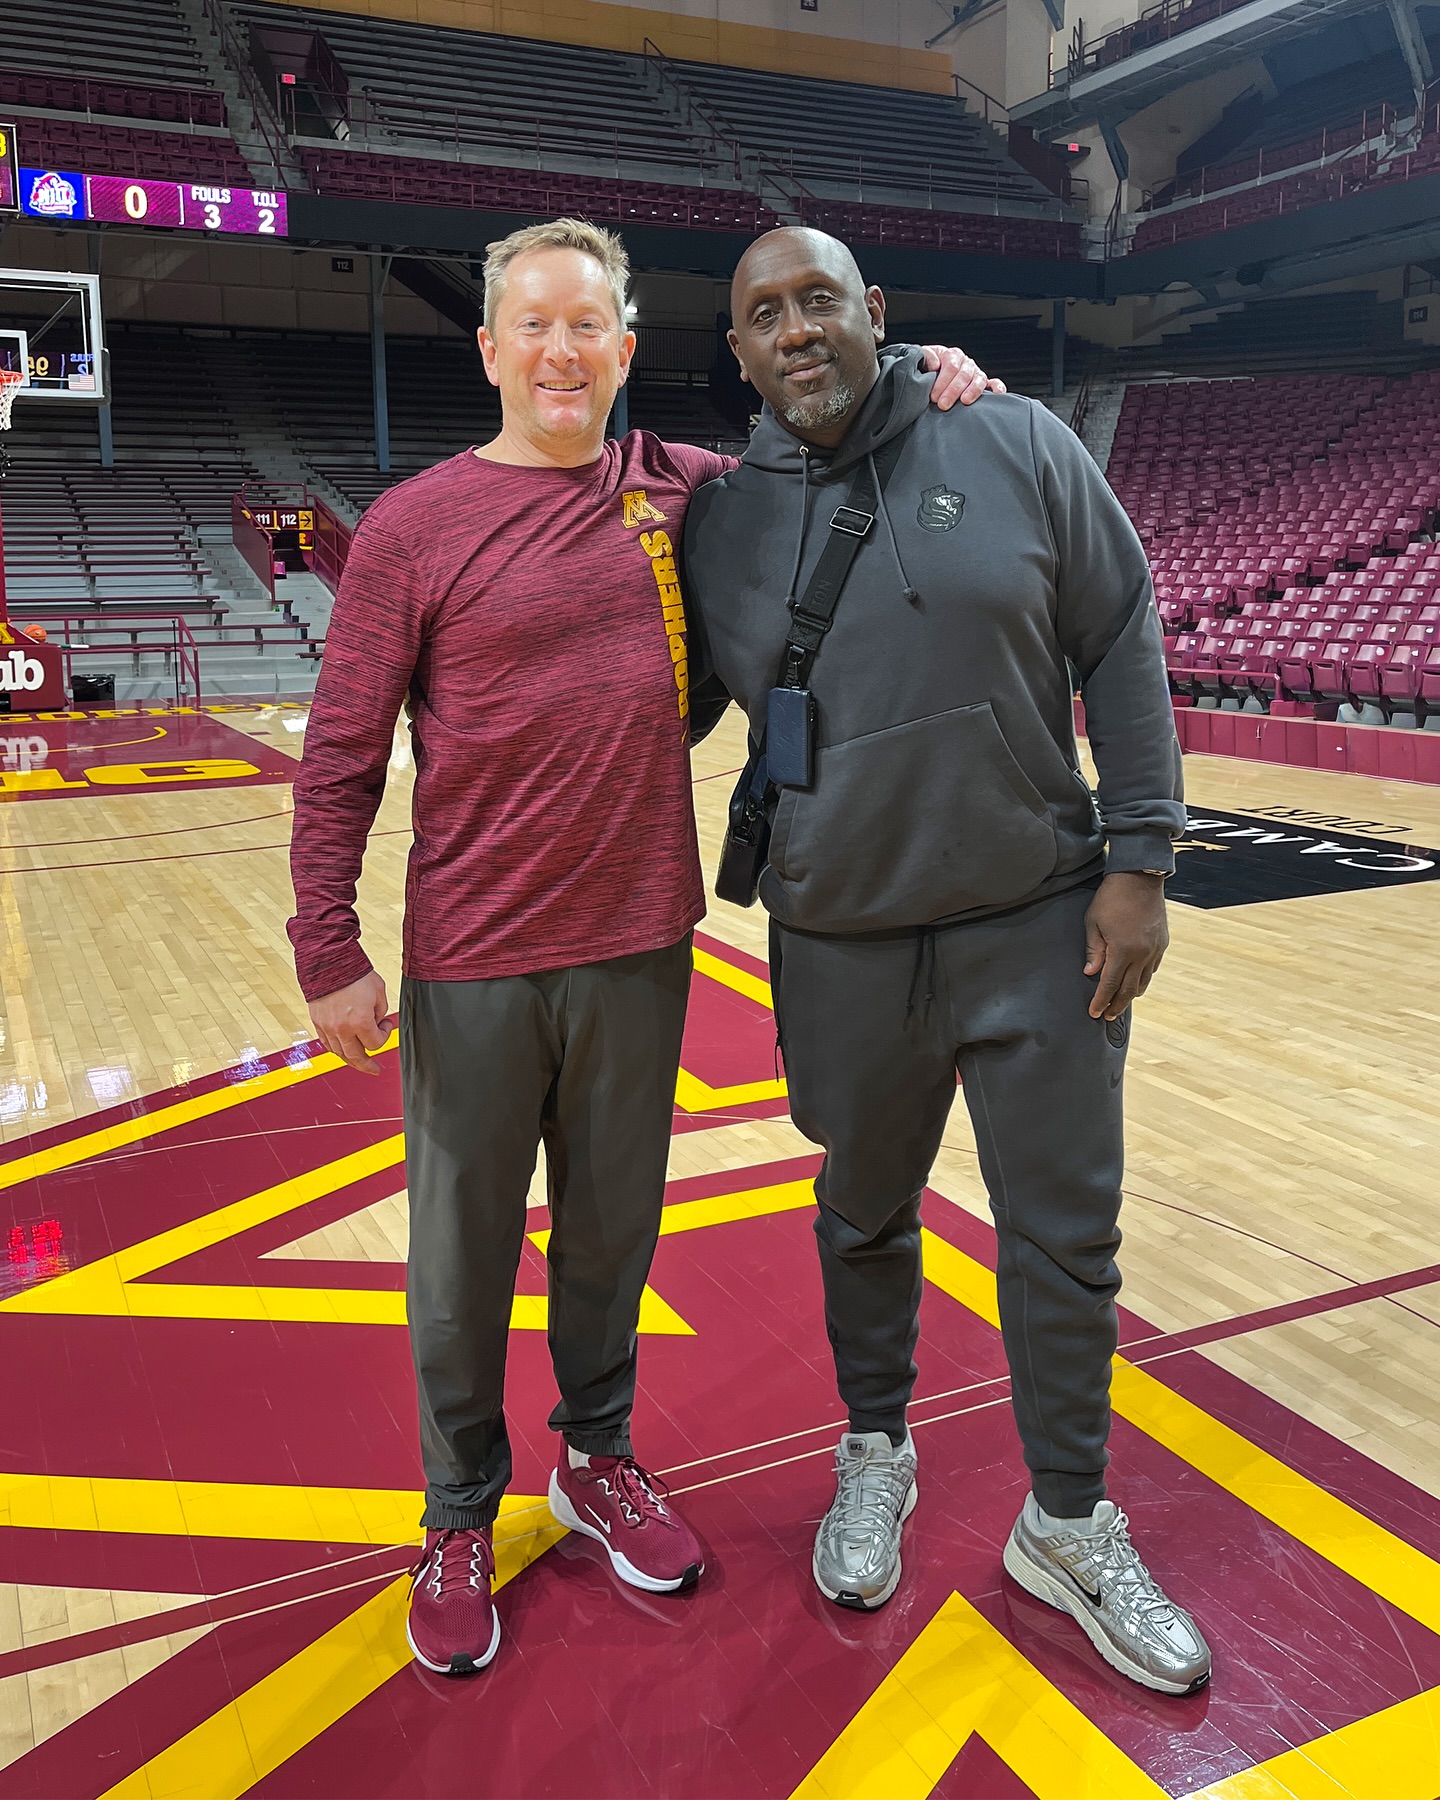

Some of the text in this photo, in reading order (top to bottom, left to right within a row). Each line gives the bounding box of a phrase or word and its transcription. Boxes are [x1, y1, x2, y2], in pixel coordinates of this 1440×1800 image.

[124, 185, 148, 219] 0
[191, 186, 231, 204] FOULS
[204, 204, 221, 229] 3
[258, 209, 276, 233] 2
[255, 513, 297, 527] 111 112
[1233, 805, 1413, 834] COURT
[1186, 815, 1436, 872] CAMB
